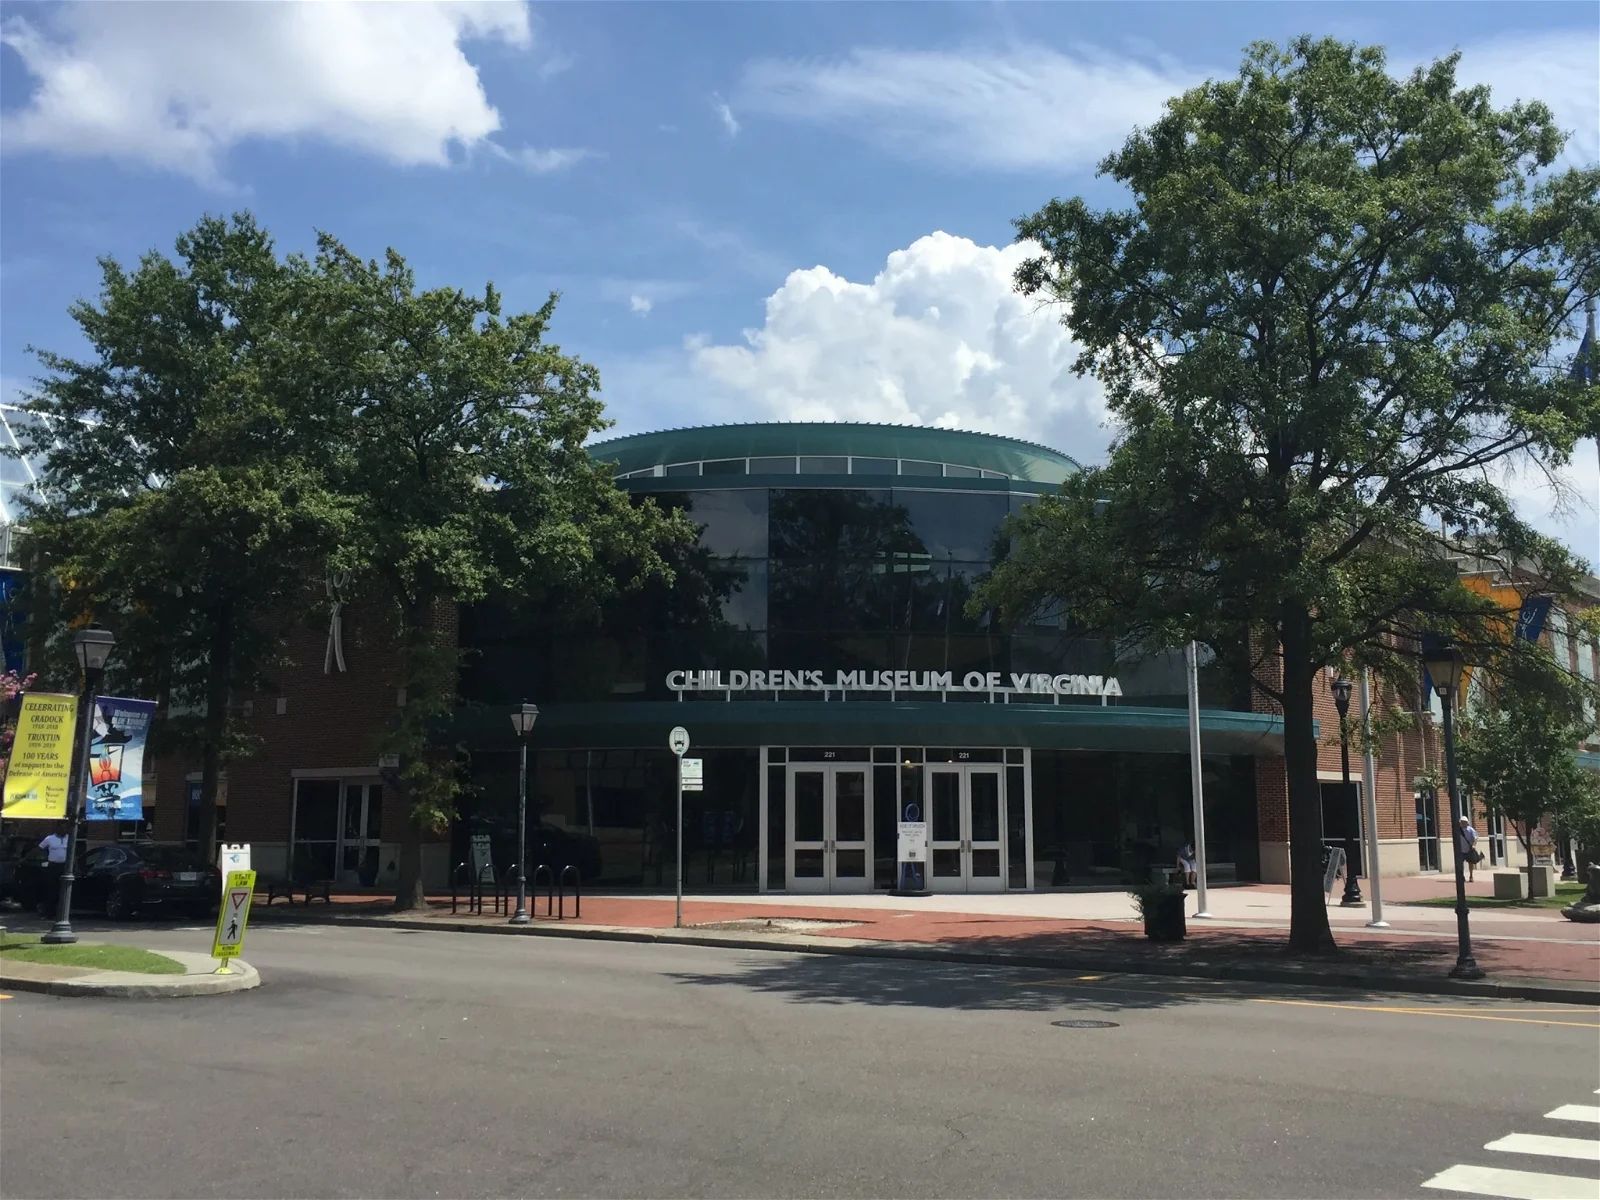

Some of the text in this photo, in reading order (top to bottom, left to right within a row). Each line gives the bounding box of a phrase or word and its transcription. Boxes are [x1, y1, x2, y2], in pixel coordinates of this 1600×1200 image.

[666, 670, 1122, 696] CHILDREN'S MUSEUM OF VIRGINIA
[25, 703, 74, 712] CELEBRATING
[31, 715, 64, 723] CRADOCK
[28, 733, 60, 741] TRUXTUN
[23, 752, 59, 760] 100 YEARS
